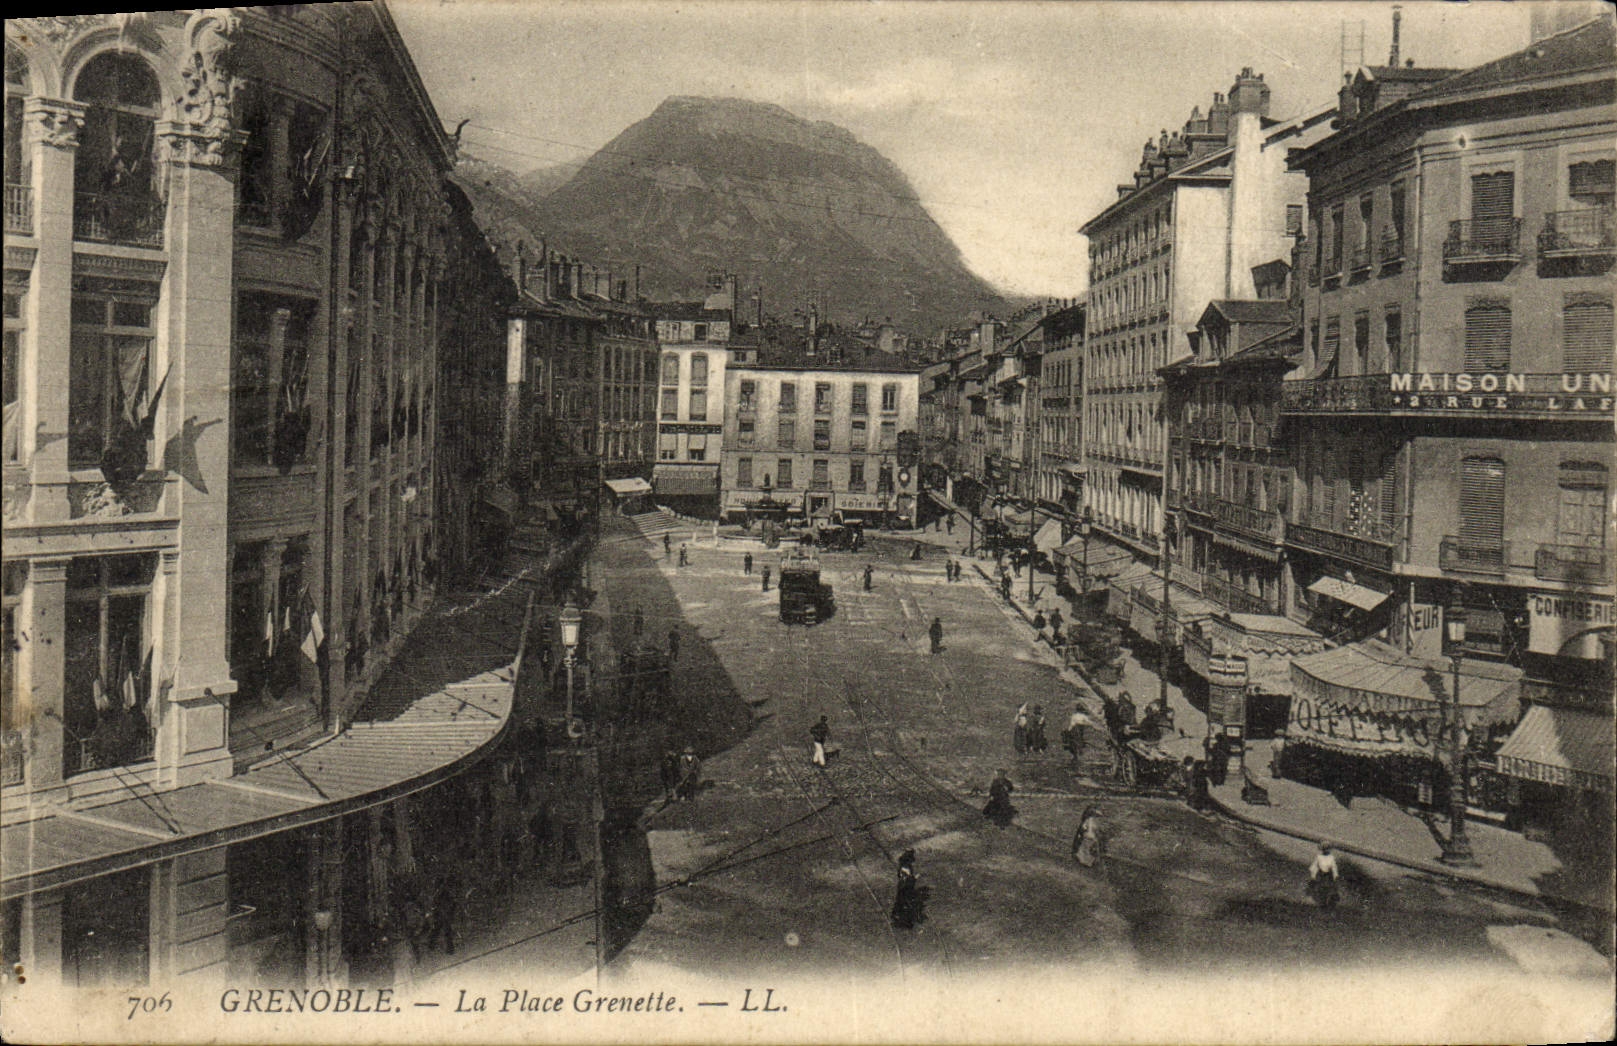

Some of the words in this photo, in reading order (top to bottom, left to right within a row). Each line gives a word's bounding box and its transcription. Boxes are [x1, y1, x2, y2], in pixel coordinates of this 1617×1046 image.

[1391, 373, 1526, 392] MAISON
[1447, 396, 1507, 409] RUE
[1535, 596, 1616, 623] CONFISERIE
